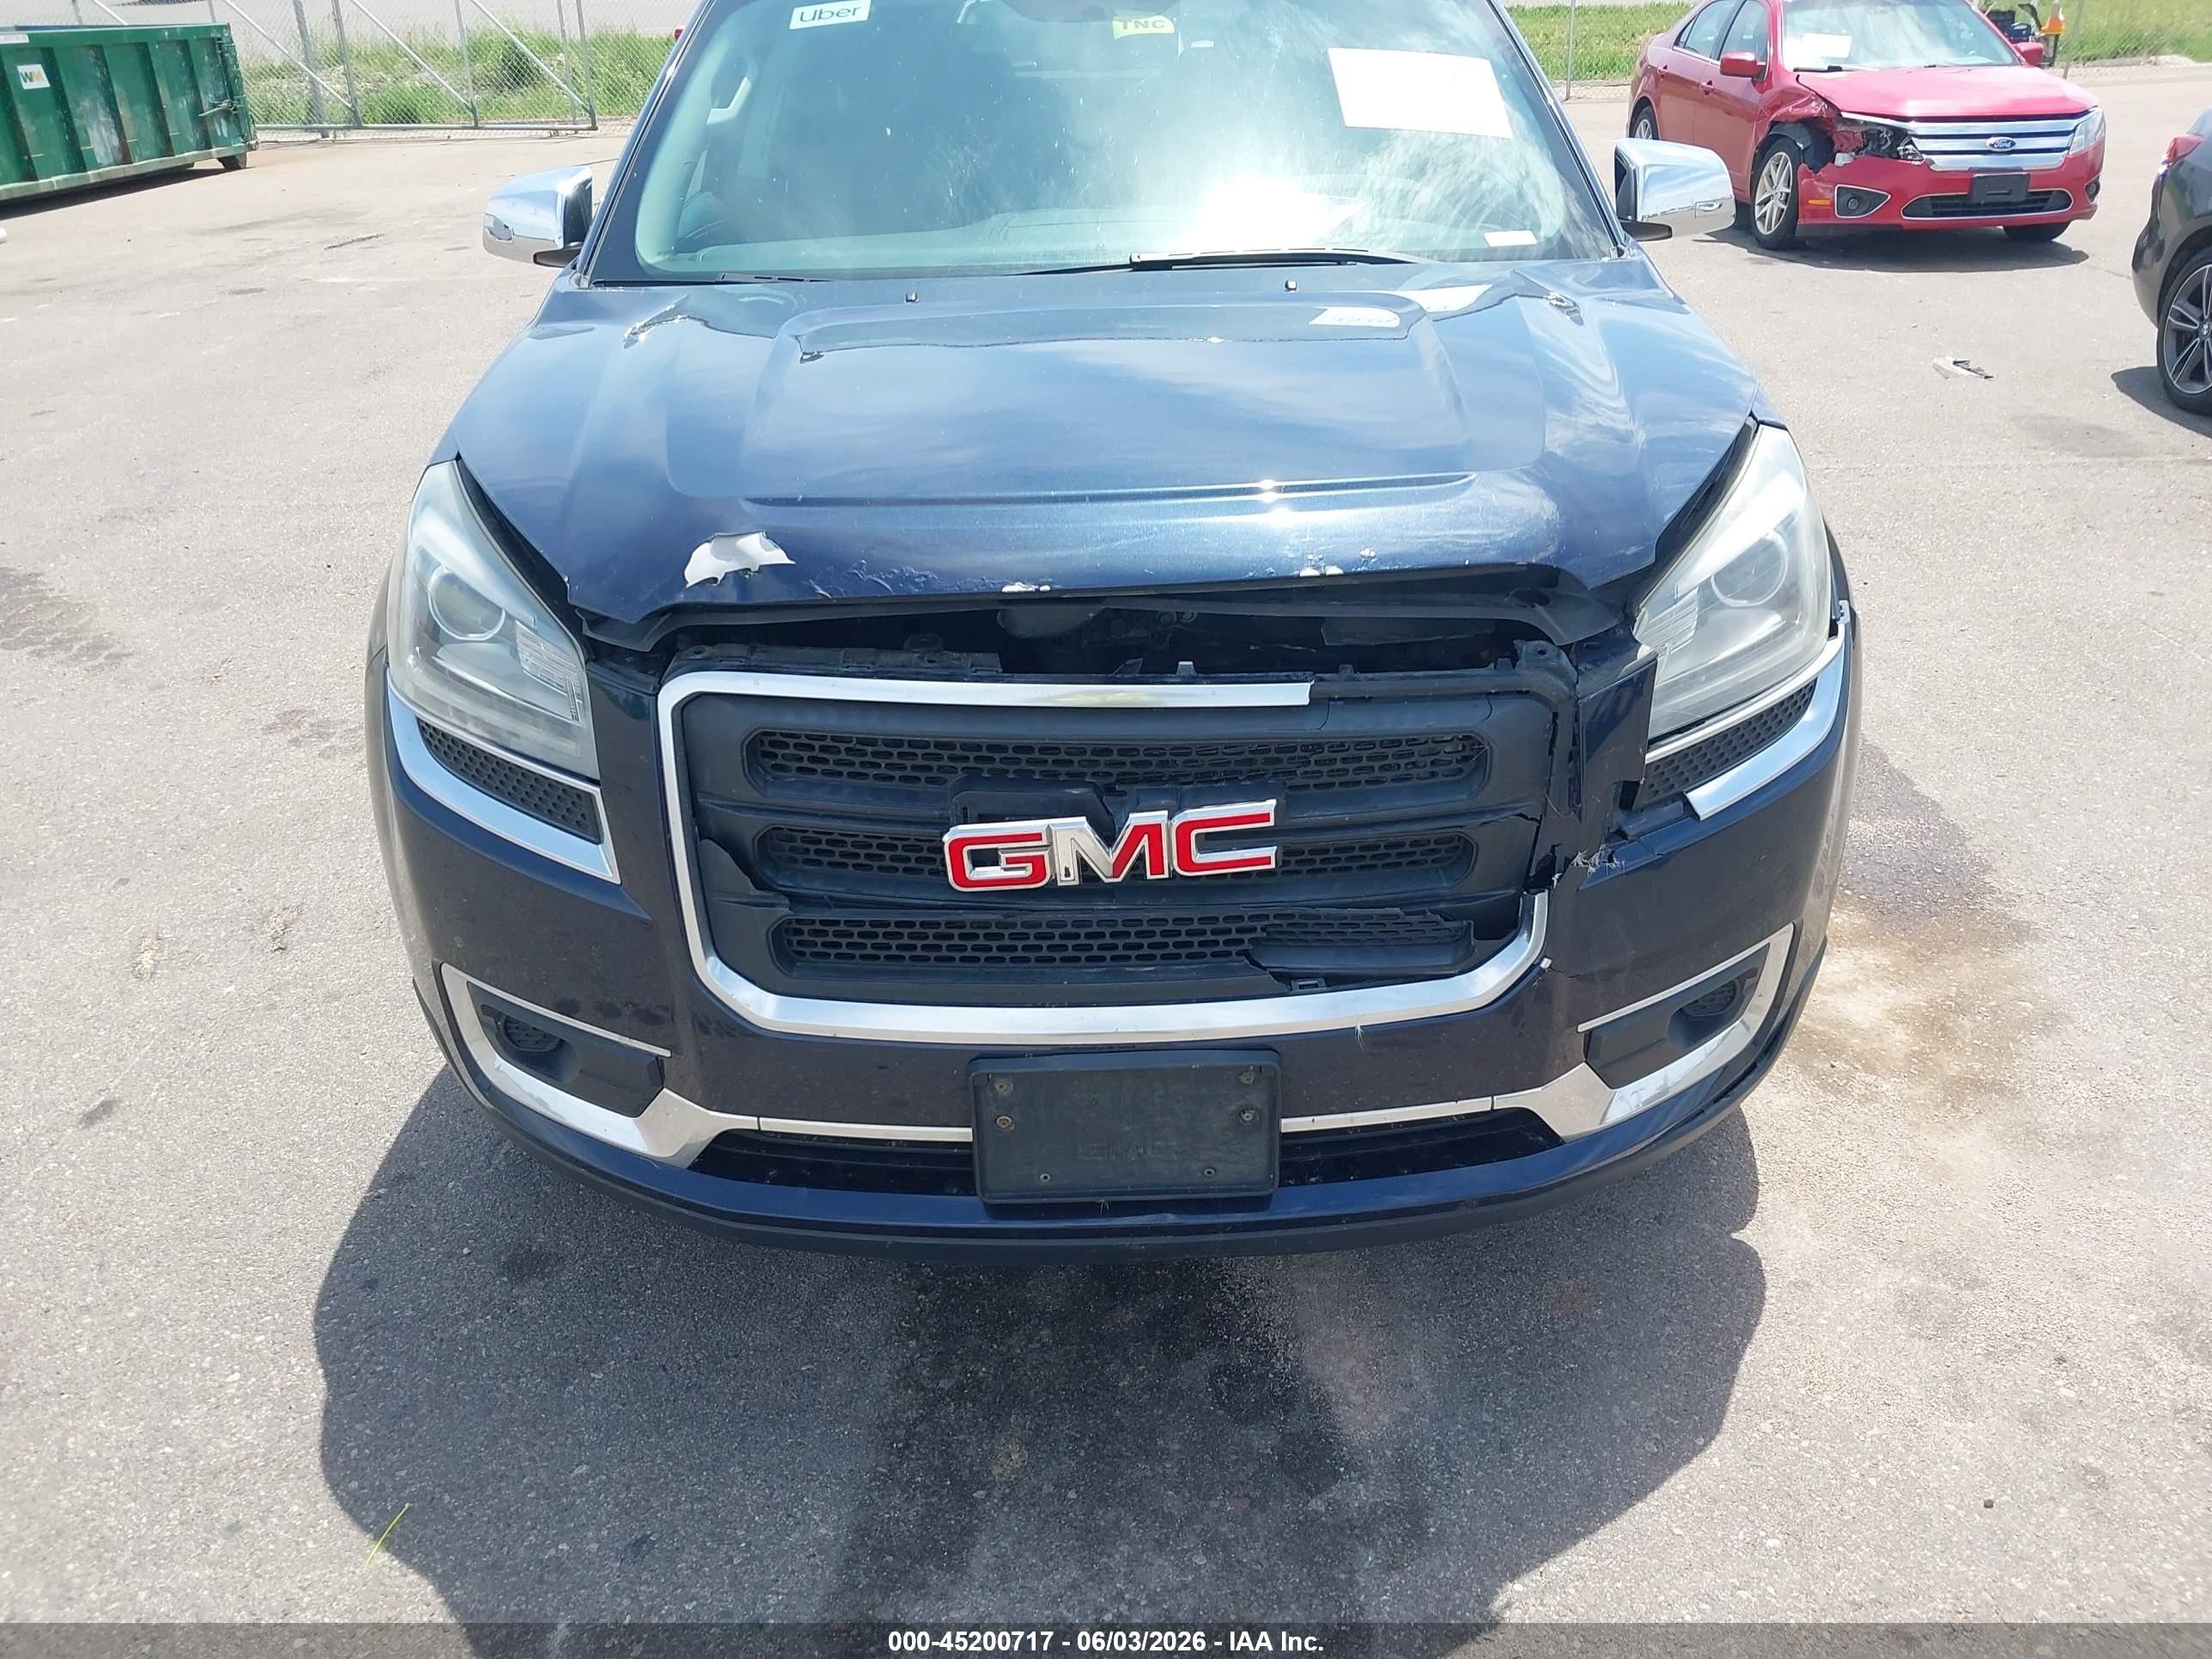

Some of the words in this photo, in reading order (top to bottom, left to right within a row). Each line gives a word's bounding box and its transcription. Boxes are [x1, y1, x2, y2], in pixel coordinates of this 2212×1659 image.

[799, 6, 862, 22] Uber
[1117, 20, 1166, 29] TNC
[942, 799, 1278, 892] GMC
